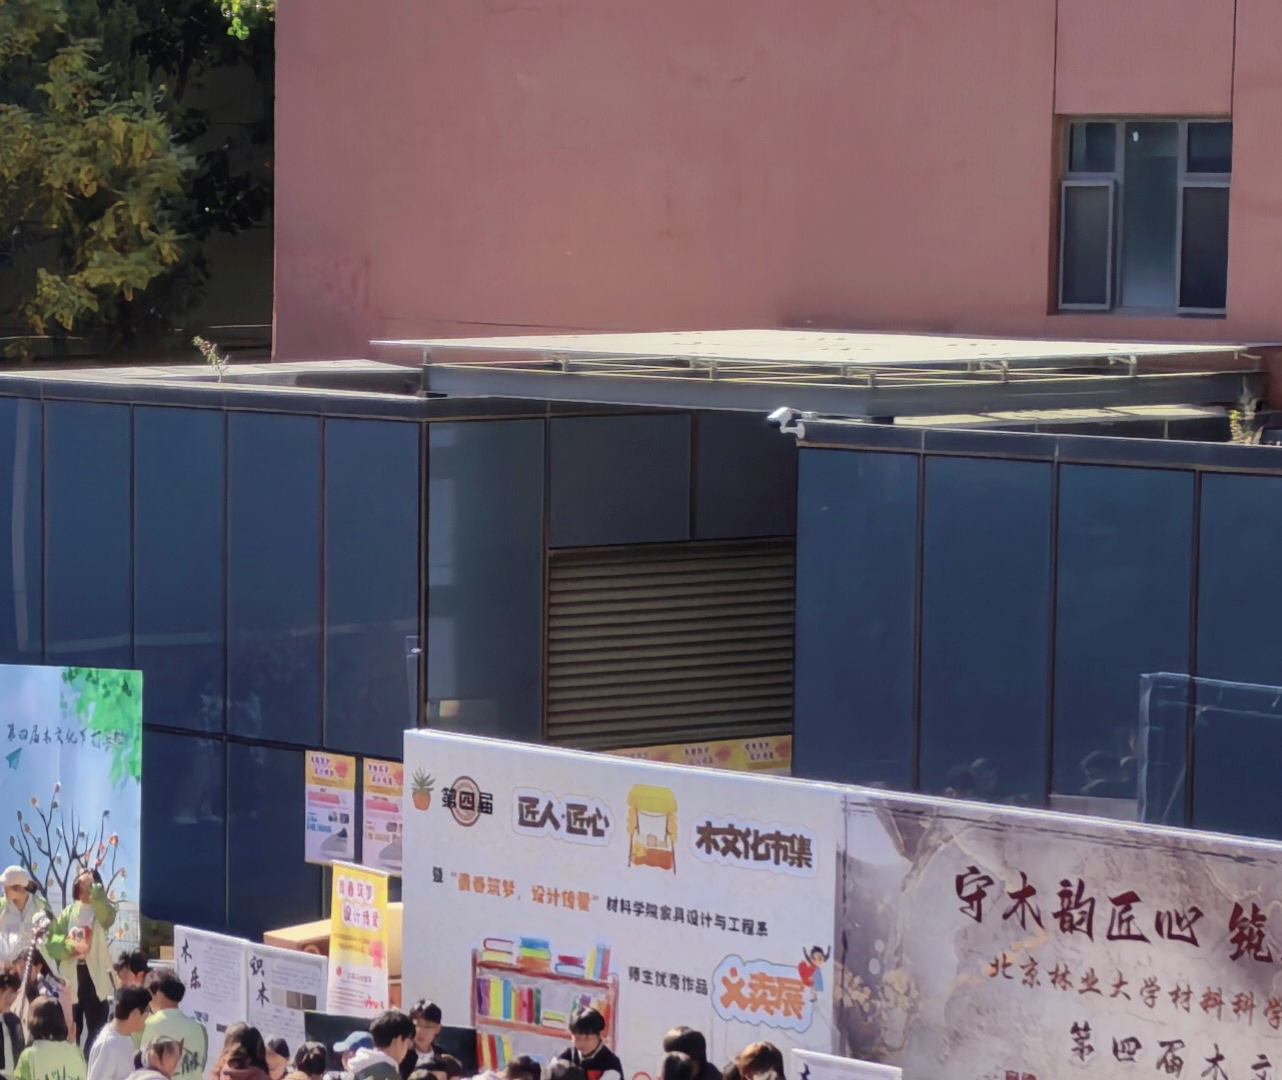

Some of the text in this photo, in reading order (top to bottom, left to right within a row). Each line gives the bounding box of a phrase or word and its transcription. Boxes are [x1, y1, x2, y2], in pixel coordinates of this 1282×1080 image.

[440, 787, 494, 816] 第四届
[695, 820, 814, 869] 木文化市集
[606, 896, 769, 937] 材料学院家具设计与工程系
[955, 865, 1205, 948] 守木韵匠心
[628, 965, 709, 997] 师生优秀作品
[720, 966, 807, 1021] 义卖展
